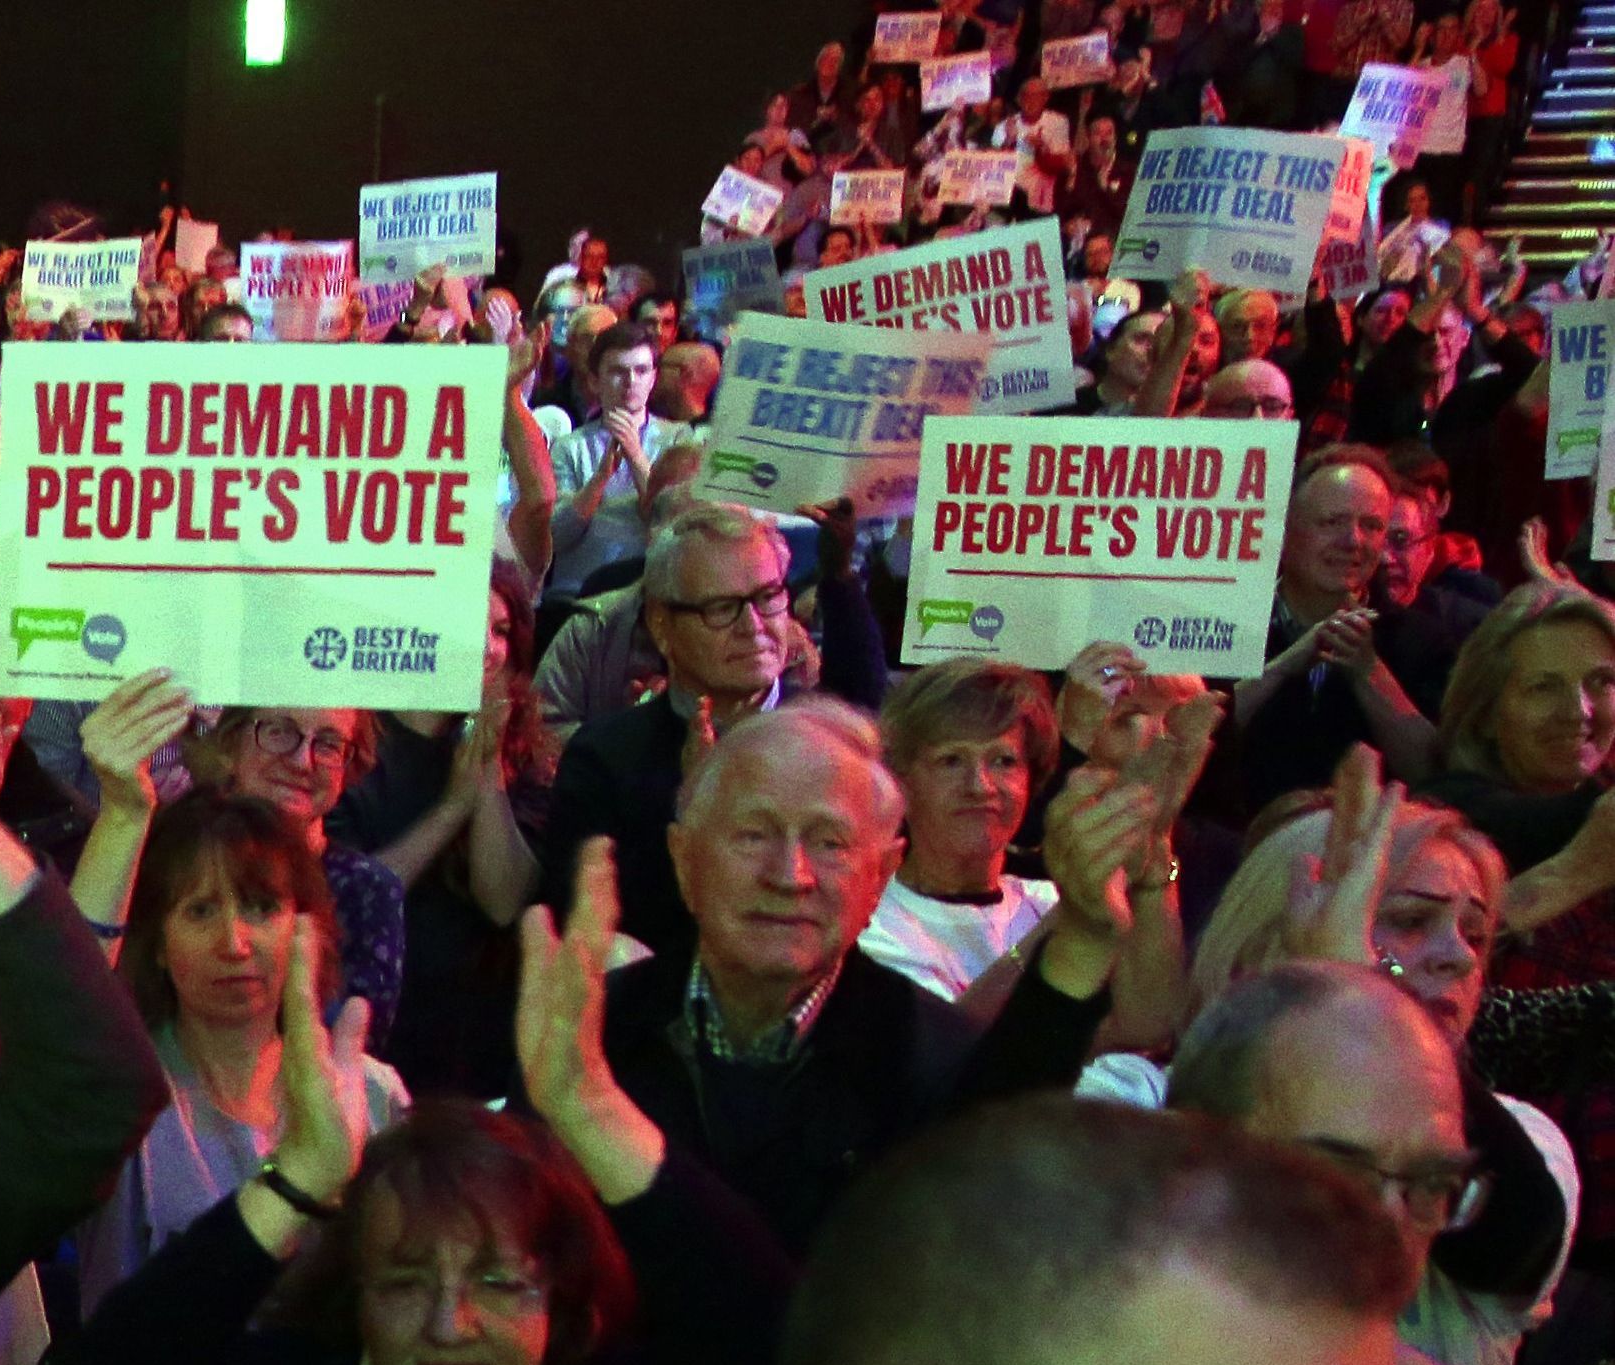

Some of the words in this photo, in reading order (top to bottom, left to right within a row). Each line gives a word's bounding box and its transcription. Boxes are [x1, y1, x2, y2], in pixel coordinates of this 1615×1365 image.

[1140, 149, 1173, 180] WE
[1173, 146, 1269, 182] REJECT
[1274, 154, 1335, 192] THIS
[363, 198, 386, 218] WE
[393, 191, 451, 216] REJECT
[458, 187, 492, 210] THIS
[1145, 183, 1226, 215] BREXIT
[1231, 186, 1296, 225] DEAL
[377, 215, 431, 241] BREXIT
[437, 212, 476, 235] DEAL
[820, 280, 866, 323] WE
[873, 248, 1013, 312] DEMAND
[1024, 241, 1046, 282] A
[972, 284, 1054, 333] VOTE
[1558, 324, 1607, 364] WE
[35, 381, 125, 455] WE
[145, 382, 408, 460] DEMAND
[427, 384, 466, 460] A
[946, 443, 1012, 496] WE
[1025, 444, 1223, 501] DEMAND
[1237, 447, 1266, 502] A
[25, 465, 300, 543] PEOPLE'S
[325, 470, 469, 547] VOTE
[933, 501, 1139, 558] PEOPLE'S
[1157, 507, 1265, 562] VOTE
[353, 626, 406, 650] BEST
[409, 628, 440, 650] for
[1169, 633, 1233, 652] BRITAIN
[1171, 617, 1212, 635] BEST
[351, 647, 437, 673] BRITAIN
